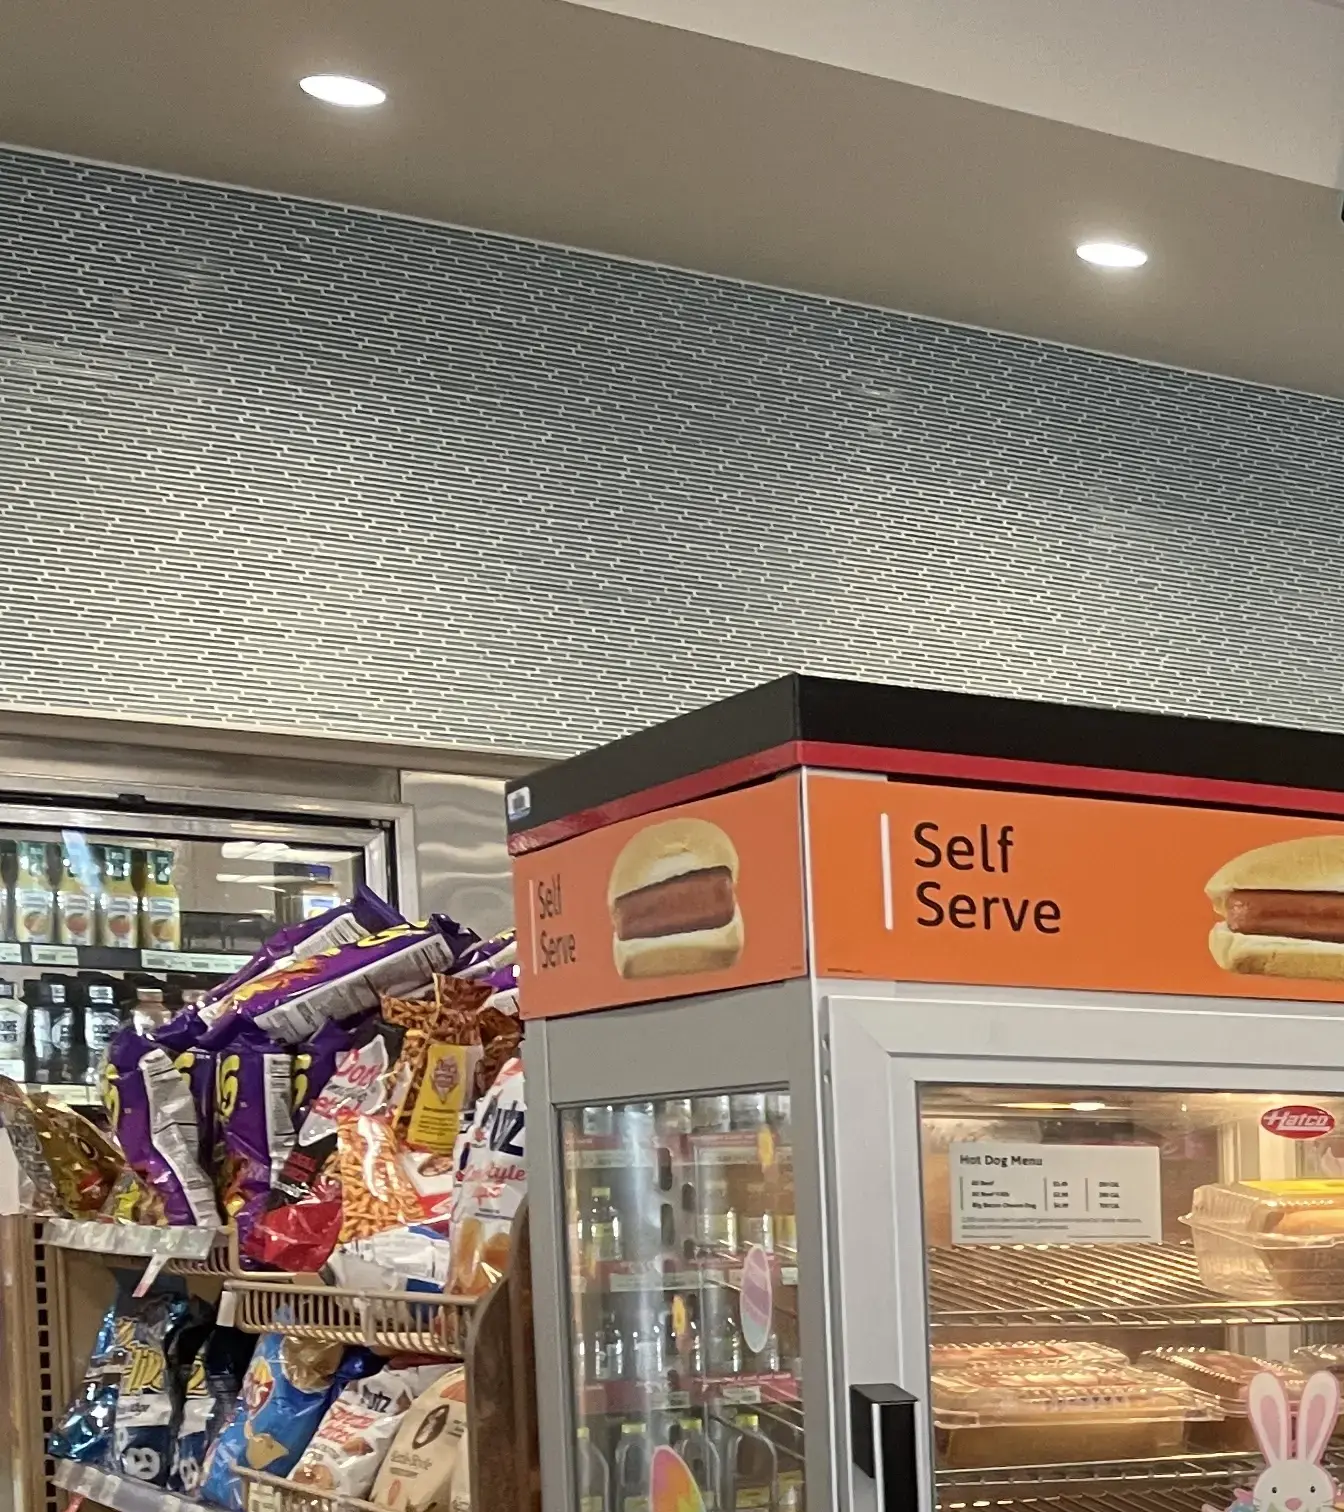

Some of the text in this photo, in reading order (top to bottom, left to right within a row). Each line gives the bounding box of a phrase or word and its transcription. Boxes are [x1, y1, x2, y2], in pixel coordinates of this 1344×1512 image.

[913, 821, 1015, 874] Self
[537, 873, 563, 921] Self
[915, 880, 1062, 935] Serve
[540, 931, 576, 970] Serve
[1263, 1110, 1331, 1132] Hatco
[960, 1155, 1043, 1168] Hot Dog Menu
